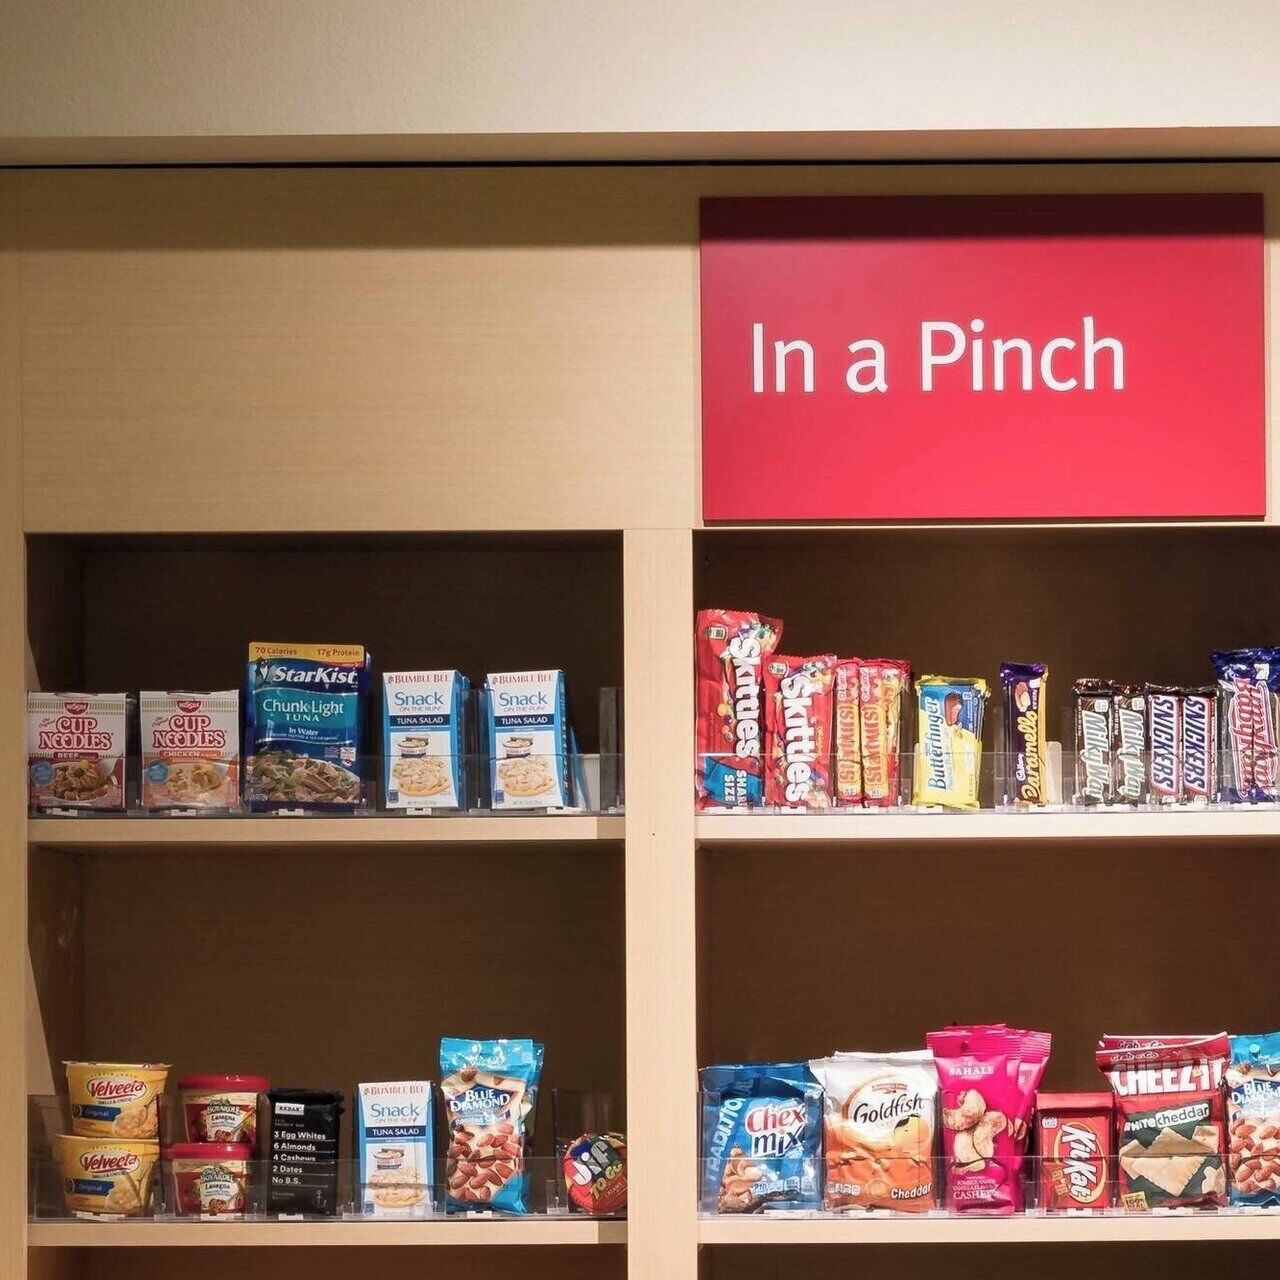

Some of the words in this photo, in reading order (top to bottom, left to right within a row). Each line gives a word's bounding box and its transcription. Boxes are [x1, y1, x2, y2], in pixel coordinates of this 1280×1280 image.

[751, 322, 815, 393] In
[846, 339, 889, 393] a
[921, 317, 1125, 393] Pinch
[255, 646, 267, 655] 70
[267, 646, 298, 656] Calories
[333, 648, 360, 658] Protein
[273, 666, 359, 685] StarKist
[394, 674, 432, 685] BUMBLE
[433, 673, 449, 684] BEE
[394, 691, 444, 707] Snack
[499, 692, 548, 708] Snack
[729, 637, 762, 759] Skittles
[263, 699, 308, 713] Chunk
[311, 700, 345, 717] Light
[56, 716, 99, 734] CUP
[169, 715, 211, 733] CUP
[286, 713, 320, 722] TUNA
[397, 717, 418, 725] TUNA
[419, 717, 444, 725] SALAD
[523, 716, 548, 724] SALAD
[39, 732, 113, 750] NOODLES
[152, 731, 226, 749] NOODLES
[781, 677, 817, 803] Skittles
[925, 696, 947, 791] Butterfinger
[1153, 697, 1175, 789] SNICKERS
[1185, 697, 1207, 789] SNICKERS
[162, 750, 200, 759] CHICKEN
[724, 774, 735, 802] SIZE
[89, 1078, 145, 1098] Velveeta
[464, 1089, 495, 1103] BLUE
[371, 1103, 420, 1118] Snack
[450, 1093, 510, 1112] DIAMOND
[853, 1092, 924, 1124] Goldfish
[746, 1103, 806, 1134] Chex
[274, 1130, 280, 1139] 3
[281, 1131, 296, 1141] Egg
[297, 1131, 326, 1141] Whites
[372, 1128, 394, 1136] TUNA
[273, 1142, 279, 1150] 6
[280, 1142, 316, 1151] Almonds
[82, 1152, 139, 1172] Velveeta
[280, 1154, 316, 1162] Cashews
[571, 1140, 612, 1186] Jif
[272, 1165, 278, 1173] 2
[280, 1165, 303, 1174] Dates
[891, 1183, 933, 1200] Cheddar
